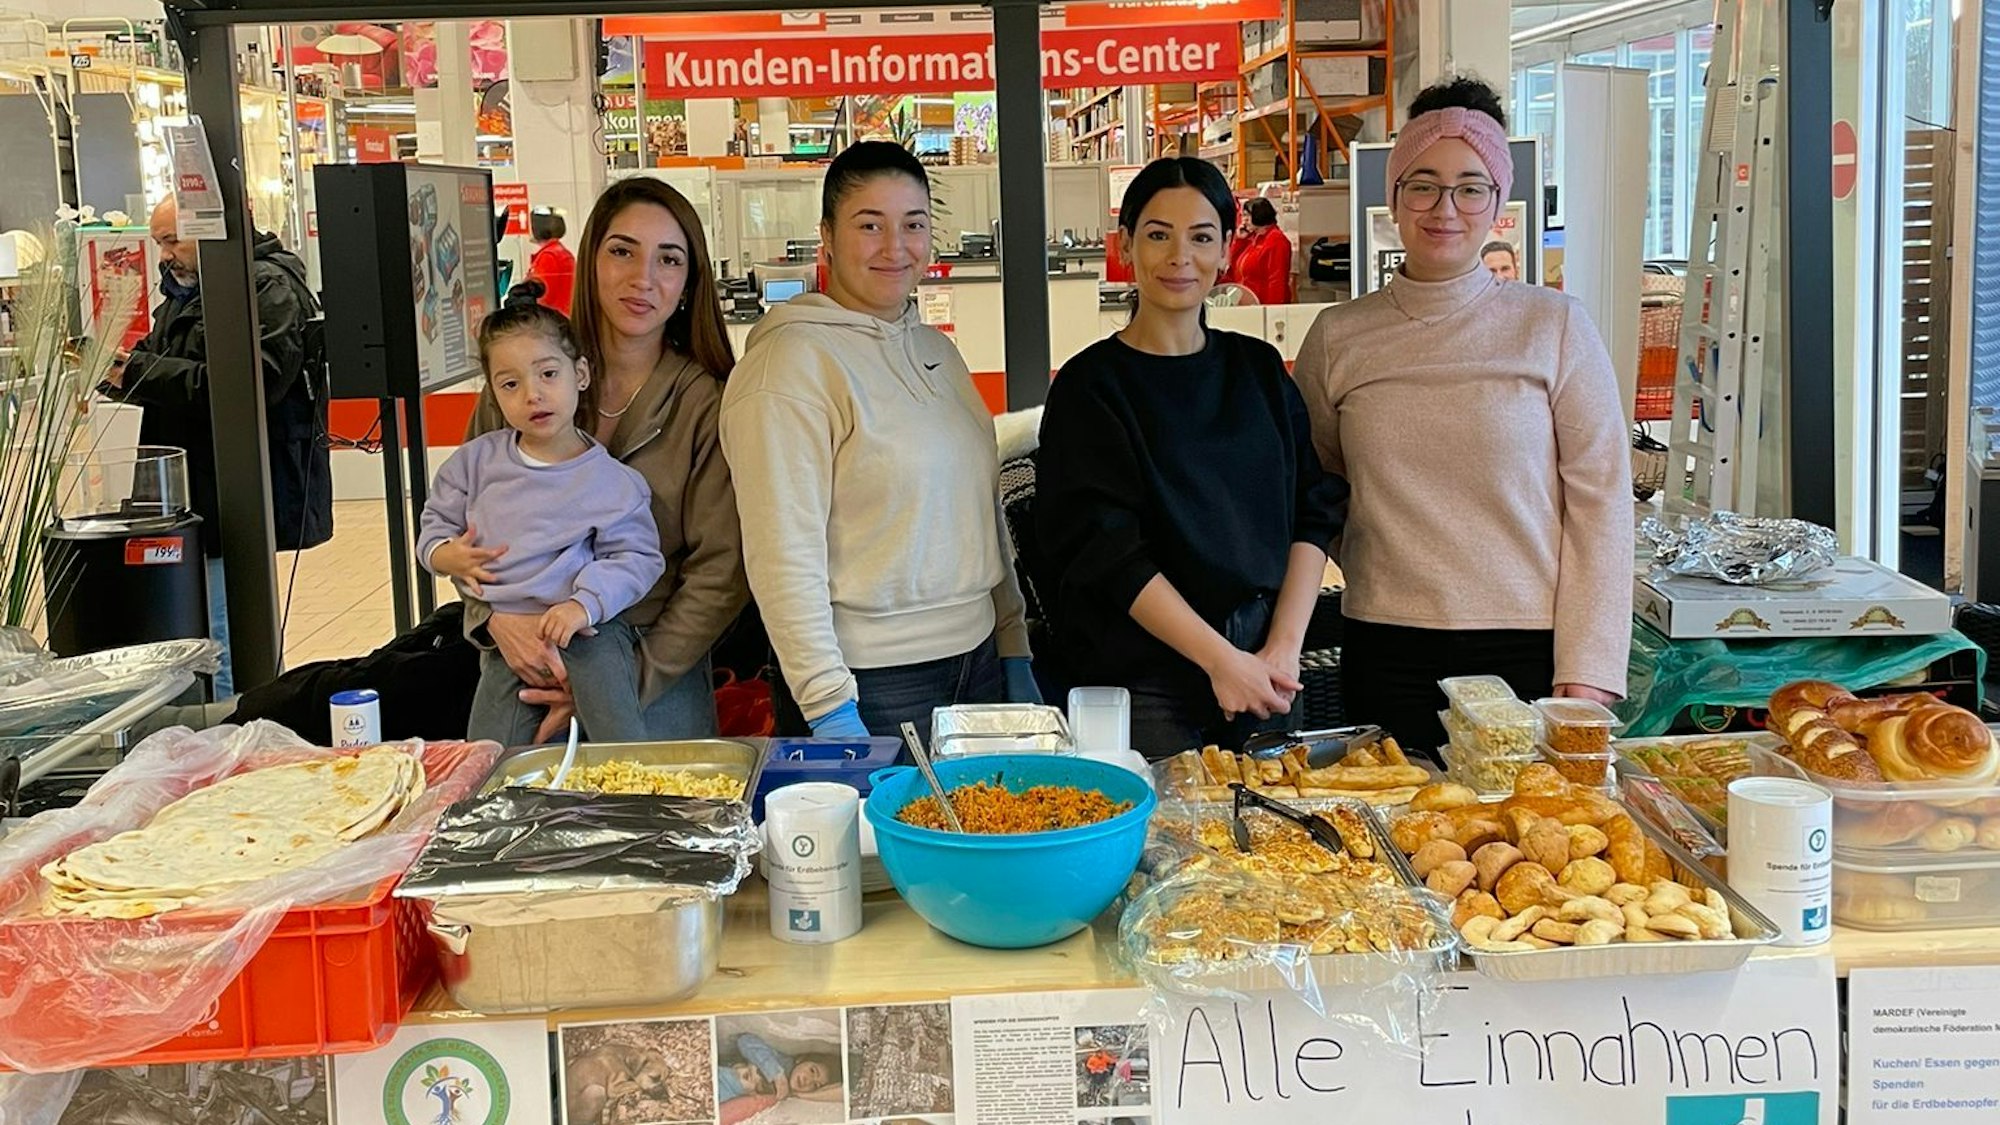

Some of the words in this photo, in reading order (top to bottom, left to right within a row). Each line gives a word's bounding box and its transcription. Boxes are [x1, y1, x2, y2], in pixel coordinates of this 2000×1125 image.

[665, 37, 1221, 88] Kunden-Informatns-Center
[1873, 1008, 1914, 1017] MARDEF
[1873, 1025, 1941, 1034] demokratische
[1943, 1023, 1992, 1032] Föderation
[1178, 999, 1347, 1108] Alle
[1417, 985, 1819, 1089] Einnahmen
[1925, 1058, 1960, 1068] Essen
[1873, 1079, 1924, 1090] Spenden
[1872, 1100, 1888, 1109] für
[1891, 1100, 1909, 1109] die
[1913, 1098, 1997, 1109] Erdbebenopfer
